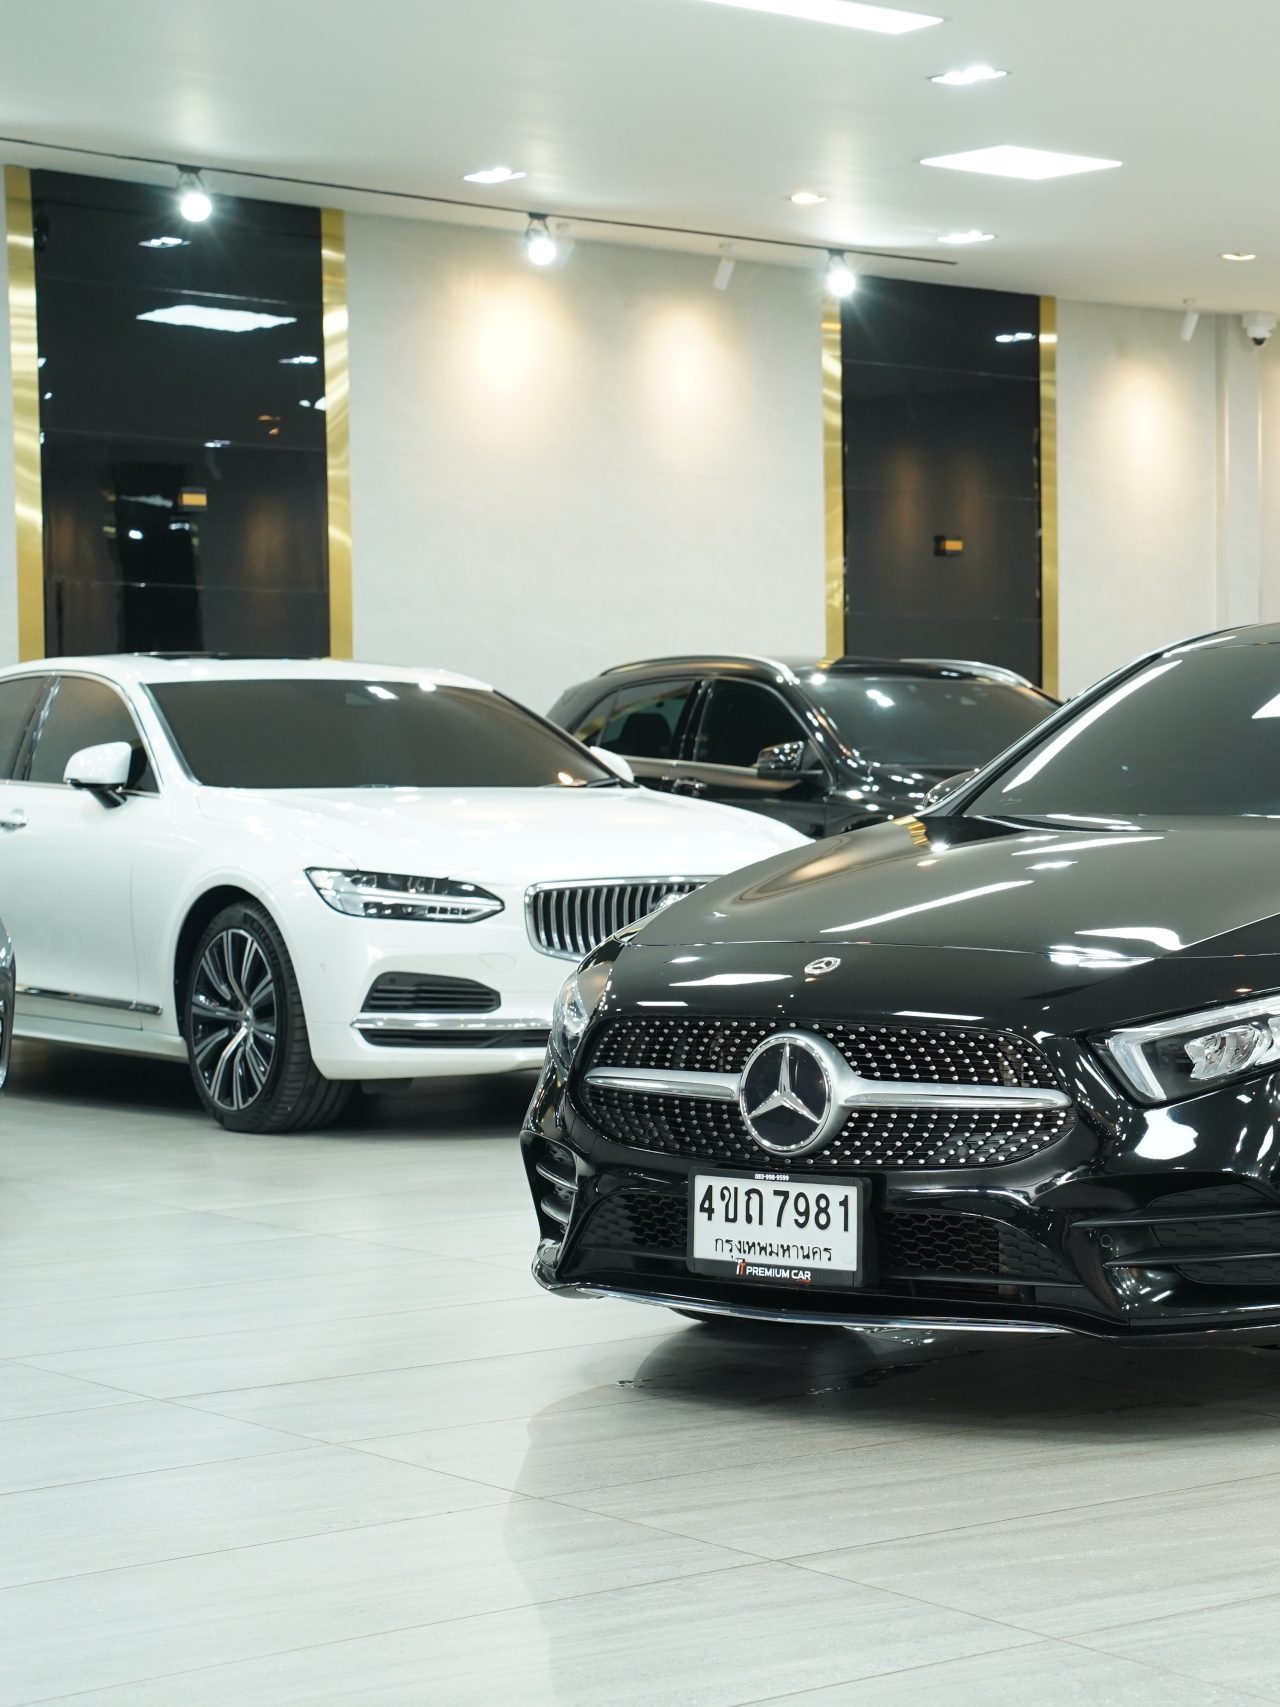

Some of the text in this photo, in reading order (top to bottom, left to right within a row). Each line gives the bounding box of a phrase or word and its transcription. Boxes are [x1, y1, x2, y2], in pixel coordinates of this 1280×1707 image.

[699, 1184, 849, 1232] 4ขถ 7981
[714, 1237, 832, 1262] กรุงเทพมหานคร
[746, 1266, 790, 1279] PREMIUM
[791, 1269, 812, 1281] CAR
